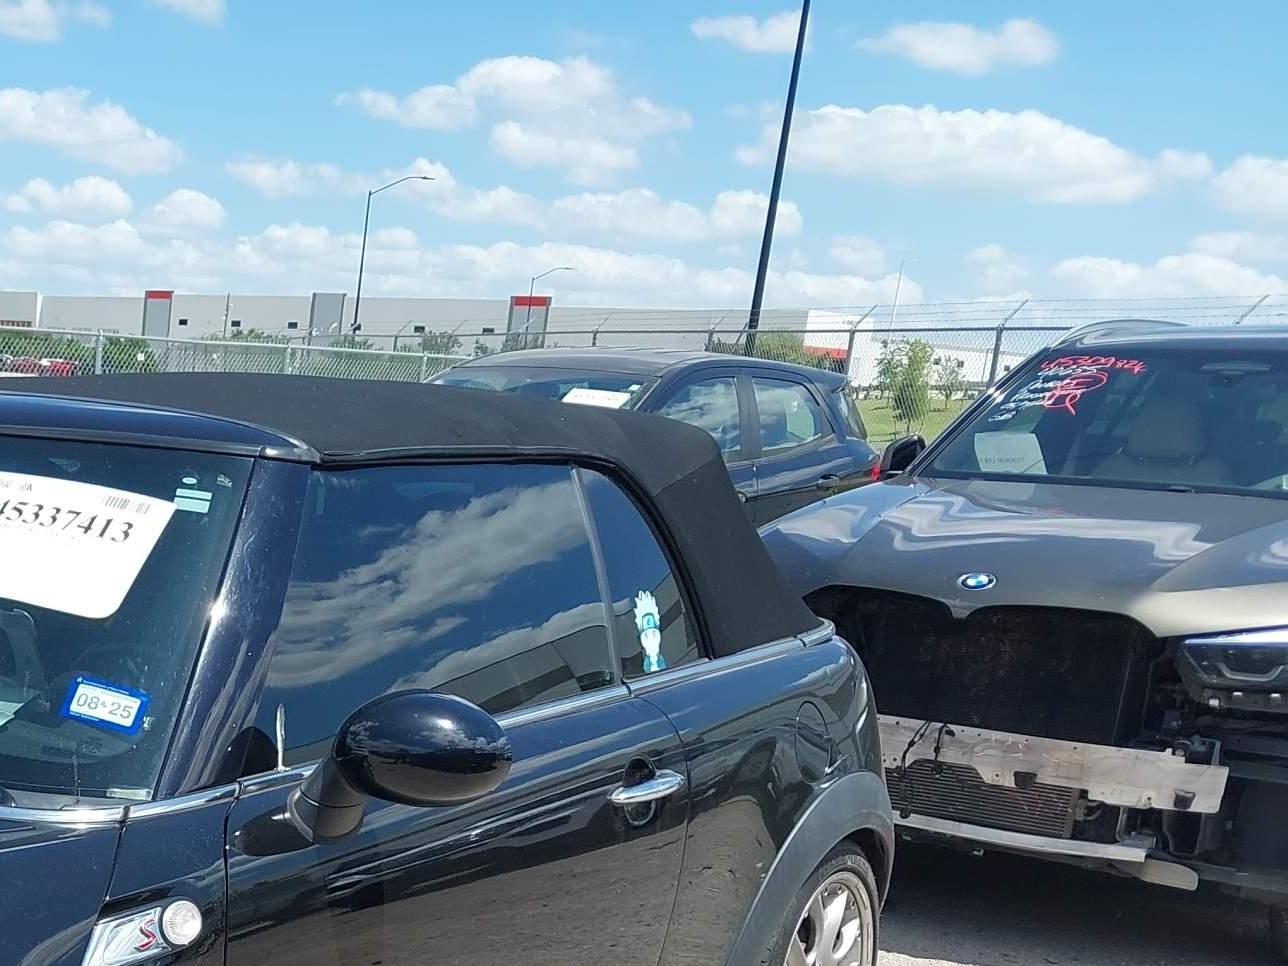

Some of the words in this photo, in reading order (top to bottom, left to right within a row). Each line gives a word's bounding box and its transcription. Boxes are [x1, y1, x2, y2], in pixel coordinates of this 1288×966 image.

[76, 693, 100, 711] 08
[107, 702, 134, 720] 25
[134, 918, 156, 950] S
